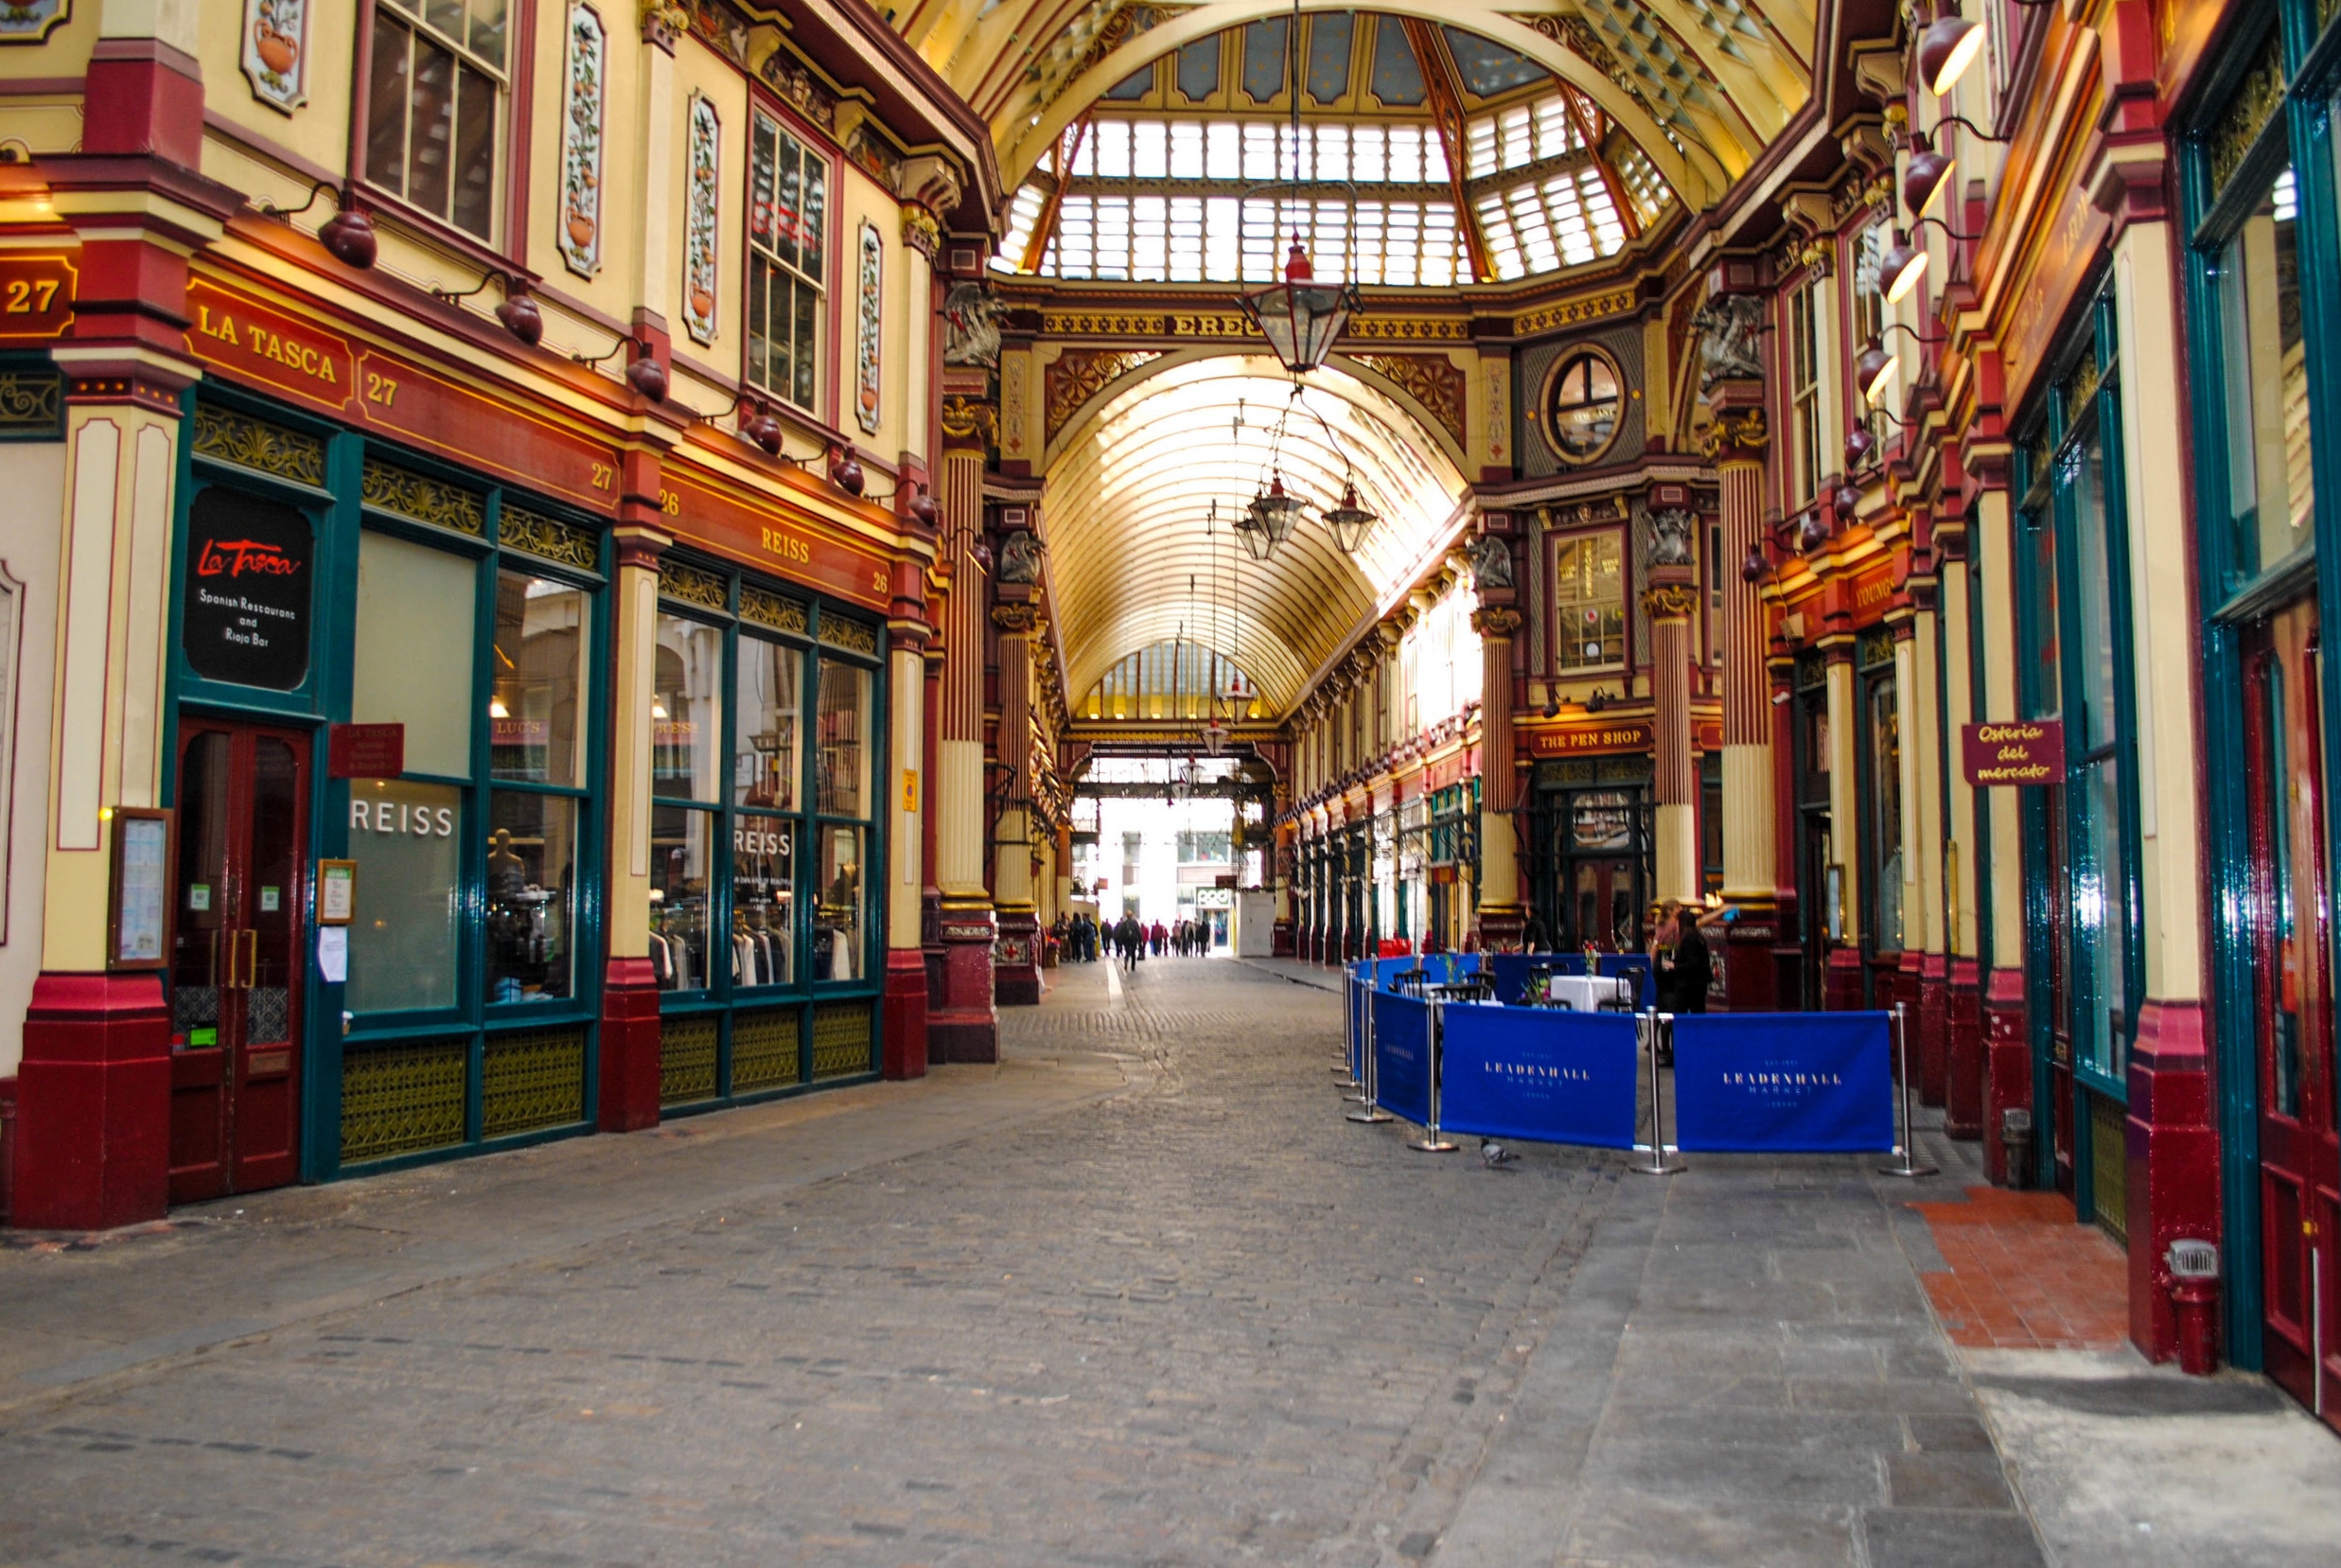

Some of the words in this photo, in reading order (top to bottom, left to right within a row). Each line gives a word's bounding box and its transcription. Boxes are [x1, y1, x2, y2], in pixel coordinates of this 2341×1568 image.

[7, 280, 60, 313] 27
[200, 306, 238, 345] LA
[249, 325, 337, 383] TASCA
[368, 372, 397, 407] 27
[591, 462, 613, 491] 27
[659, 487, 679, 517] 26
[761, 526, 810, 564] REISS
[198, 538, 232, 576] La
[216, 538, 301, 577] Tasca
[872, 571, 888, 594] 26
[200, 588, 238, 608] Spanish
[240, 596, 296, 620] Restaurant
[238, 616, 258, 628] and
[225, 626, 250, 644] Rioja
[252, 632, 270, 647] Bar
[1540, 735, 1567, 749] THE
[1571, 731, 1598, 748] PEN
[1603, 730, 1642, 745] SHOP
[1978, 723, 2043, 743] Osteria
[1998, 745, 2029, 762] del
[1978, 763, 2051, 781] mercato
[350, 800, 452, 837] REISS
[734, 830, 790, 856] REISS
[1197, 888, 1229, 906] pod
[1485, 1061, 1591, 1082] LEADENHALL
[1723, 1072, 1842, 1085] LEADENHALL
[1749, 1085, 1812, 1095] MARKET
